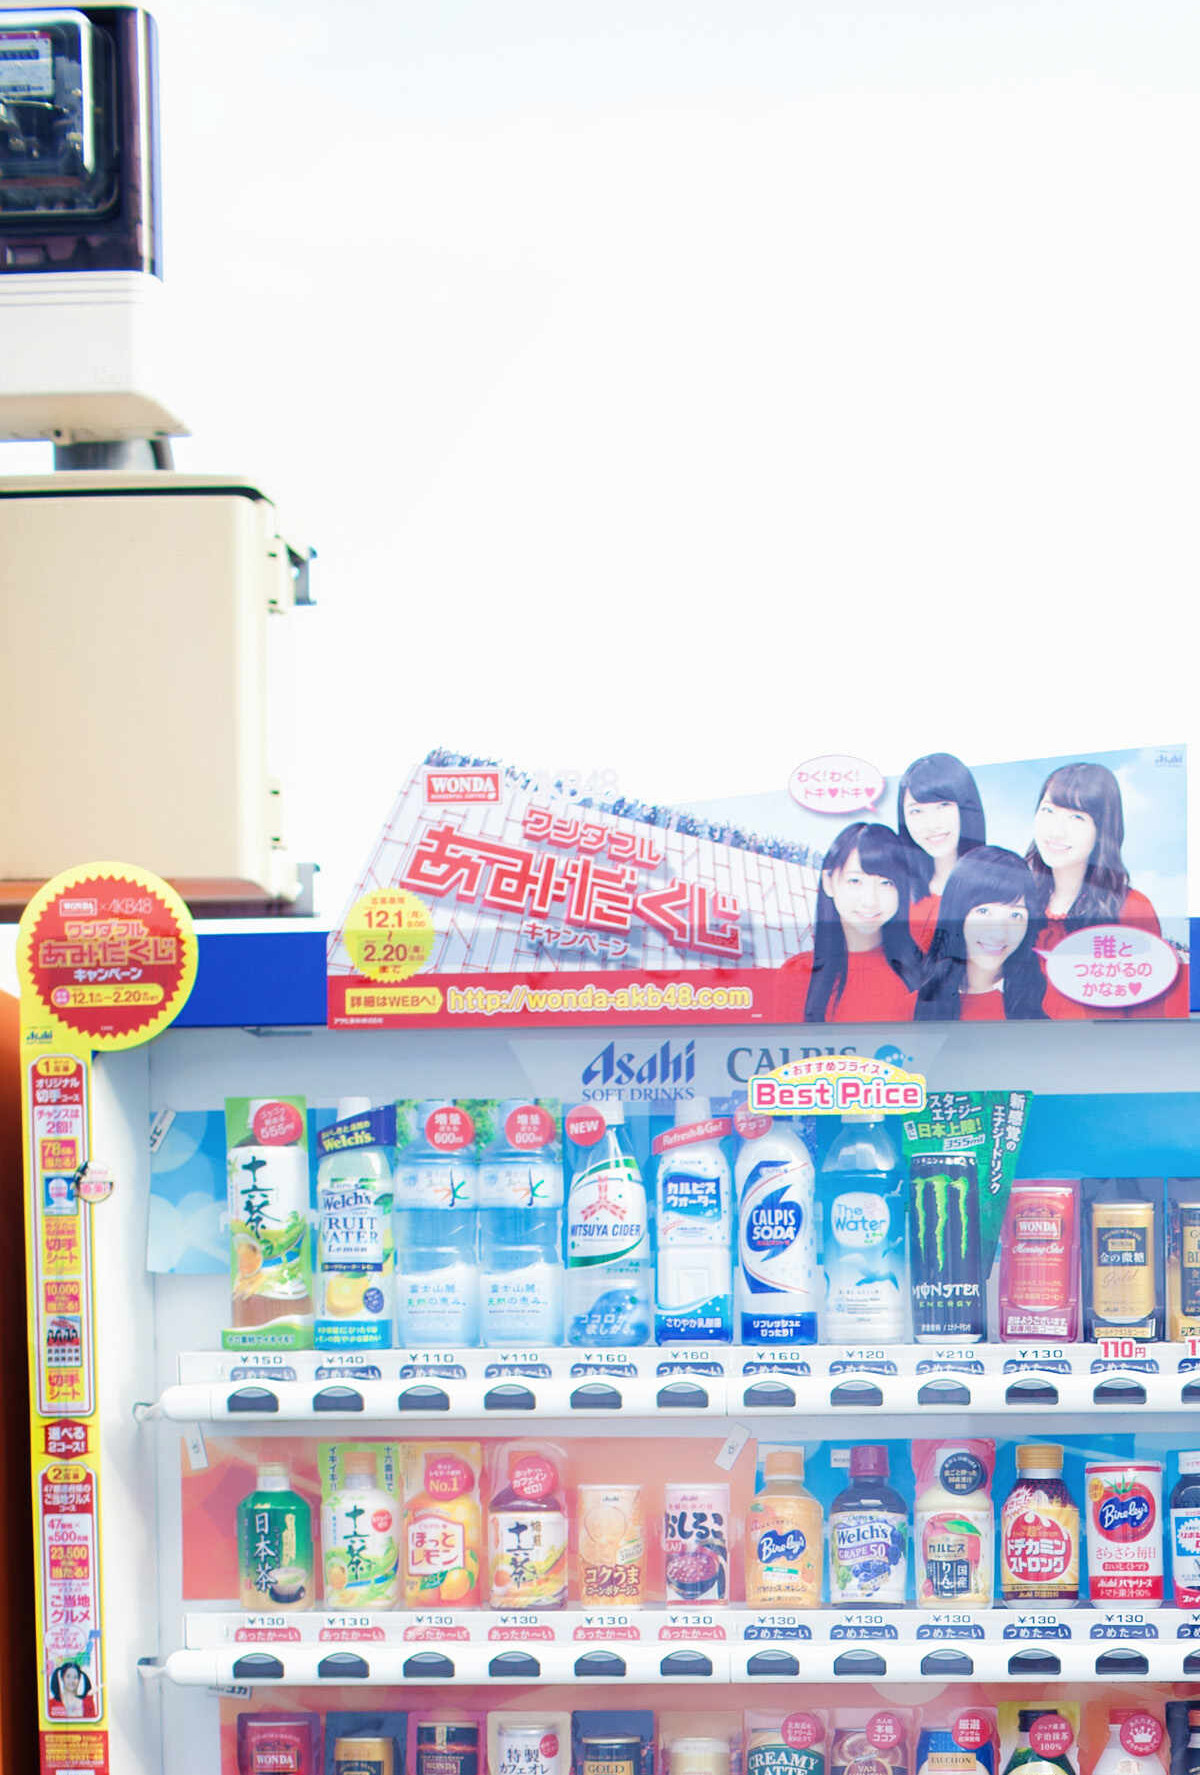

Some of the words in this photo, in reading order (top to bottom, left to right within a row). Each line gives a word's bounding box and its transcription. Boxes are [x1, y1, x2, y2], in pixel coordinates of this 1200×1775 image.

[431, 776, 496, 794] WONDA
[524, 808, 668, 870] ワンダフル
[401, 823, 743, 959] あみだくじ
[363, 910, 404, 929] 12.1
[523, 921, 630, 958] キャンペーン
[1093, 935, 1133, 960] 誰と
[39, 937, 177, 968] あみだくじ
[363, 944, 408, 962] 2.20
[73, 967, 143, 982] キャンペーン
[1073, 962, 1153, 979] つながるの
[447, 985, 753, 1014] http://wonda-akb48.com
[581, 1038, 696, 1087] Asahi
[792, 1060, 881, 1077] おすすめプライス
[581, 1087, 624, 1101] SOFT
[630, 1086, 695, 1101] DRINKS
[756, 1081, 832, 1106] Best
[840, 1080, 920, 1106] Price
[929, 1093, 969, 1108] スター
[931, 1104, 983, 1122] エナジー
[569, 1119, 599, 1135] NEW
[917, 1117, 983, 1139] 日本上陸!
[989, 1104, 1006, 1195] エナジードリンク
[665, 1181, 717, 1195] カルピス
[240, 1155, 283, 1242] 十六茶
[665, 1194, 717, 1208] ウォーター
[751, 1208, 796, 1226] CALPIS
[836, 1203, 864, 1217] The
[611, 1221, 641, 1238] CIDER
[834, 1216, 888, 1231] Water
[1018, 1221, 1058, 1234] WONDA
[752, 1225, 797, 1241] SODA
[912, 1282, 981, 1299] MONSTER
[918, 1300, 973, 1309] ENERGY
[240, 1355, 284, 1366] ¥150
[326, 1355, 365, 1365] ¥140
[583, 1353, 628, 1363] ¥160
[845, 1350, 885, 1360] ¥120
[935, 1350, 974, 1359] ¥210
[1018, 1349, 1064, 1359] ¥130
[1099, 1340, 1147, 1359] 110円
[47, 1426, 86, 1441] 選べる
[429, 1479, 460, 1493] No.1
[664, 1511, 725, 1540] おしるこ
[411, 1532, 456, 1549] ほっと
[836, 1523, 890, 1546] Welch's
[254, 1511, 277, 1593] 日本茶
[410, 1550, 458, 1567] レモン
[869, 1543, 886, 1557] 50
[1009, 1557, 1065, 1574] ストロング
[584, 1567, 642, 1586] コクうま
[327, 1617, 370, 1627] ¥130
[585, 1615, 629, 1625] ¥130
[844, 1614, 884, 1624] ¥130
[1104, 1613, 1144, 1623] ¥130
[256, 1753, 295, 1766] WONDA
[505, 1748, 540, 1764] 特製
[499, 1763, 550, 1775] カフェオレ
[587, 1764, 625, 1775] GOLD
[857, 1765, 876, 1773] VAN
